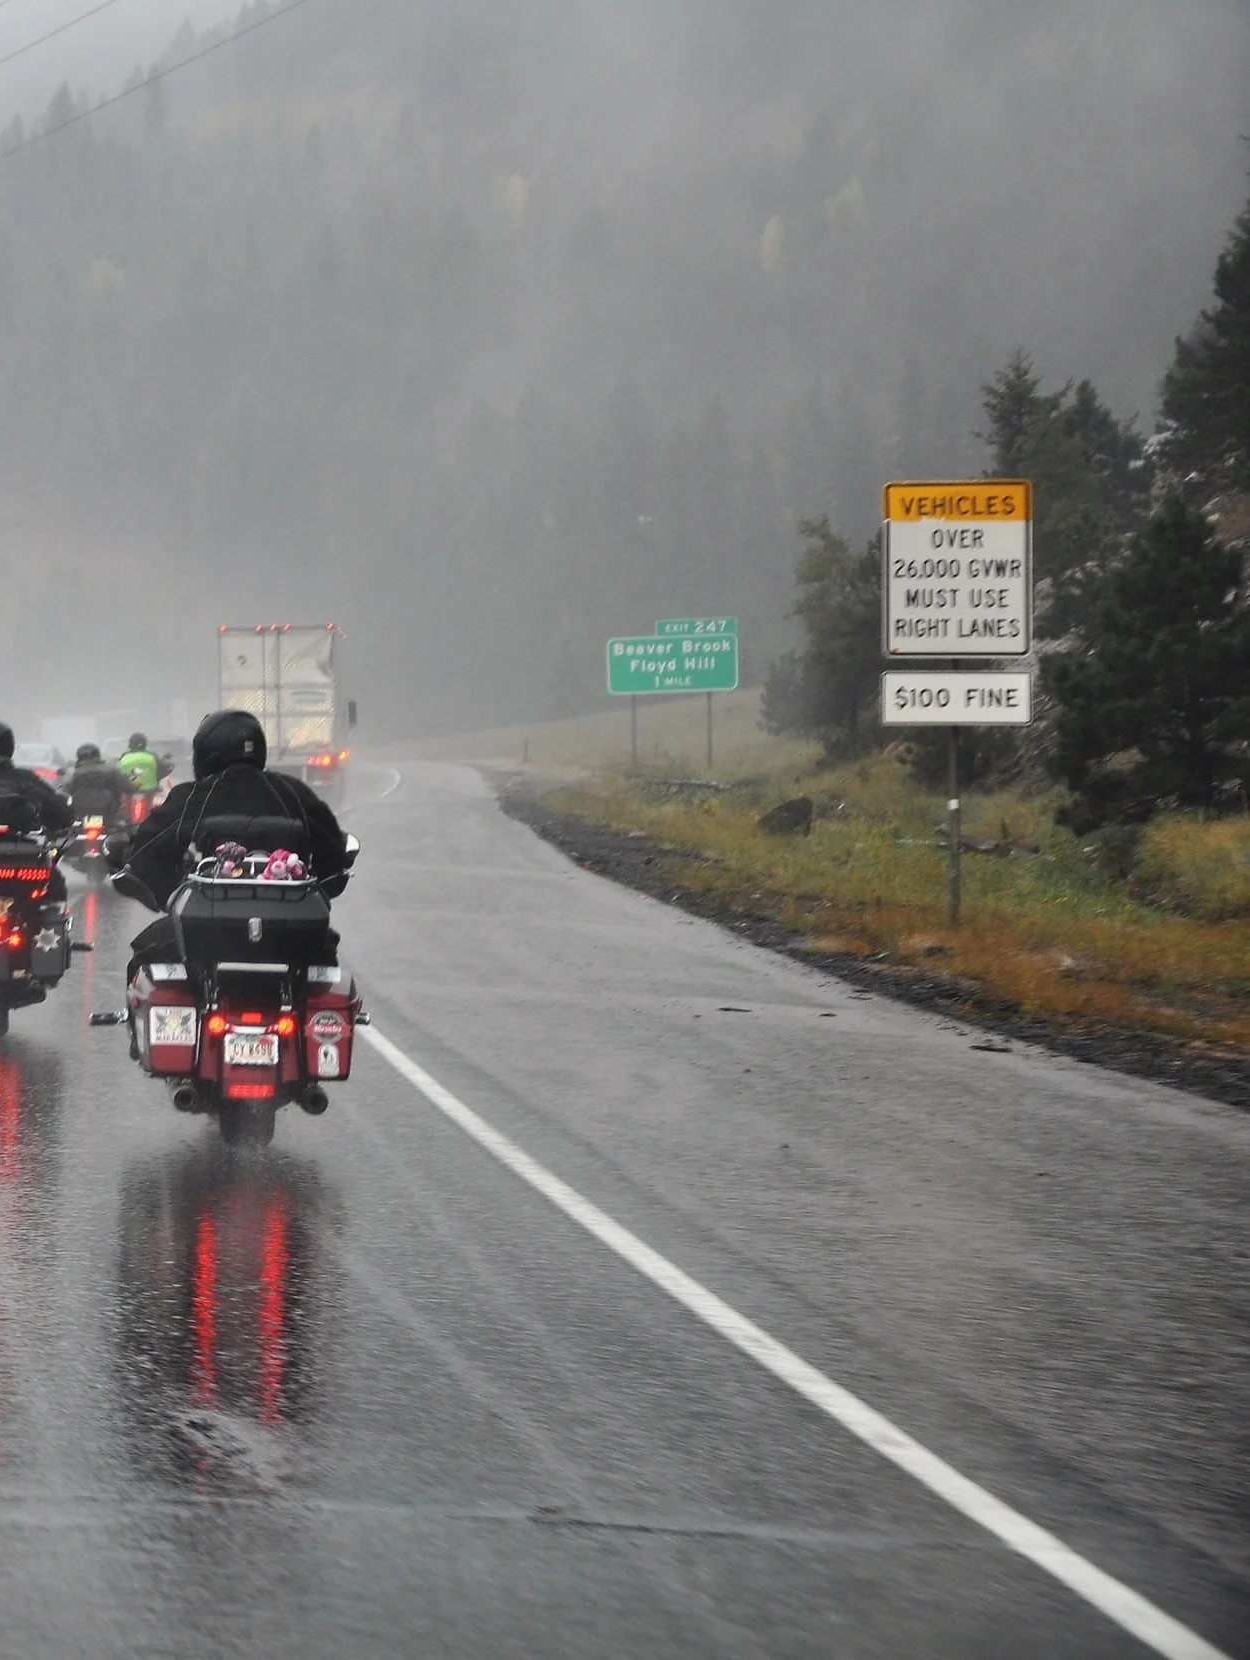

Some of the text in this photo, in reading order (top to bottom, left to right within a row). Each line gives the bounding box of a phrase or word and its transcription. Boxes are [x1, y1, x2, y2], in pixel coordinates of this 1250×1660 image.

[900, 496, 1016, 516] VEHICLES
[931, 529, 984, 549] OVER
[968, 559, 1022, 579] GVWR
[905, 588, 1010, 608] MUST USE
[664, 619, 727, 634] EXIT 247
[894, 618, 1020, 637] RIGHT LANES
[613, 639, 731, 656] Beaver Brook
[630, 657, 716, 674] Floyd Hill
[654, 676, 692, 688] 1 MILE
[894, 687, 1019, 709] $100 FINE
